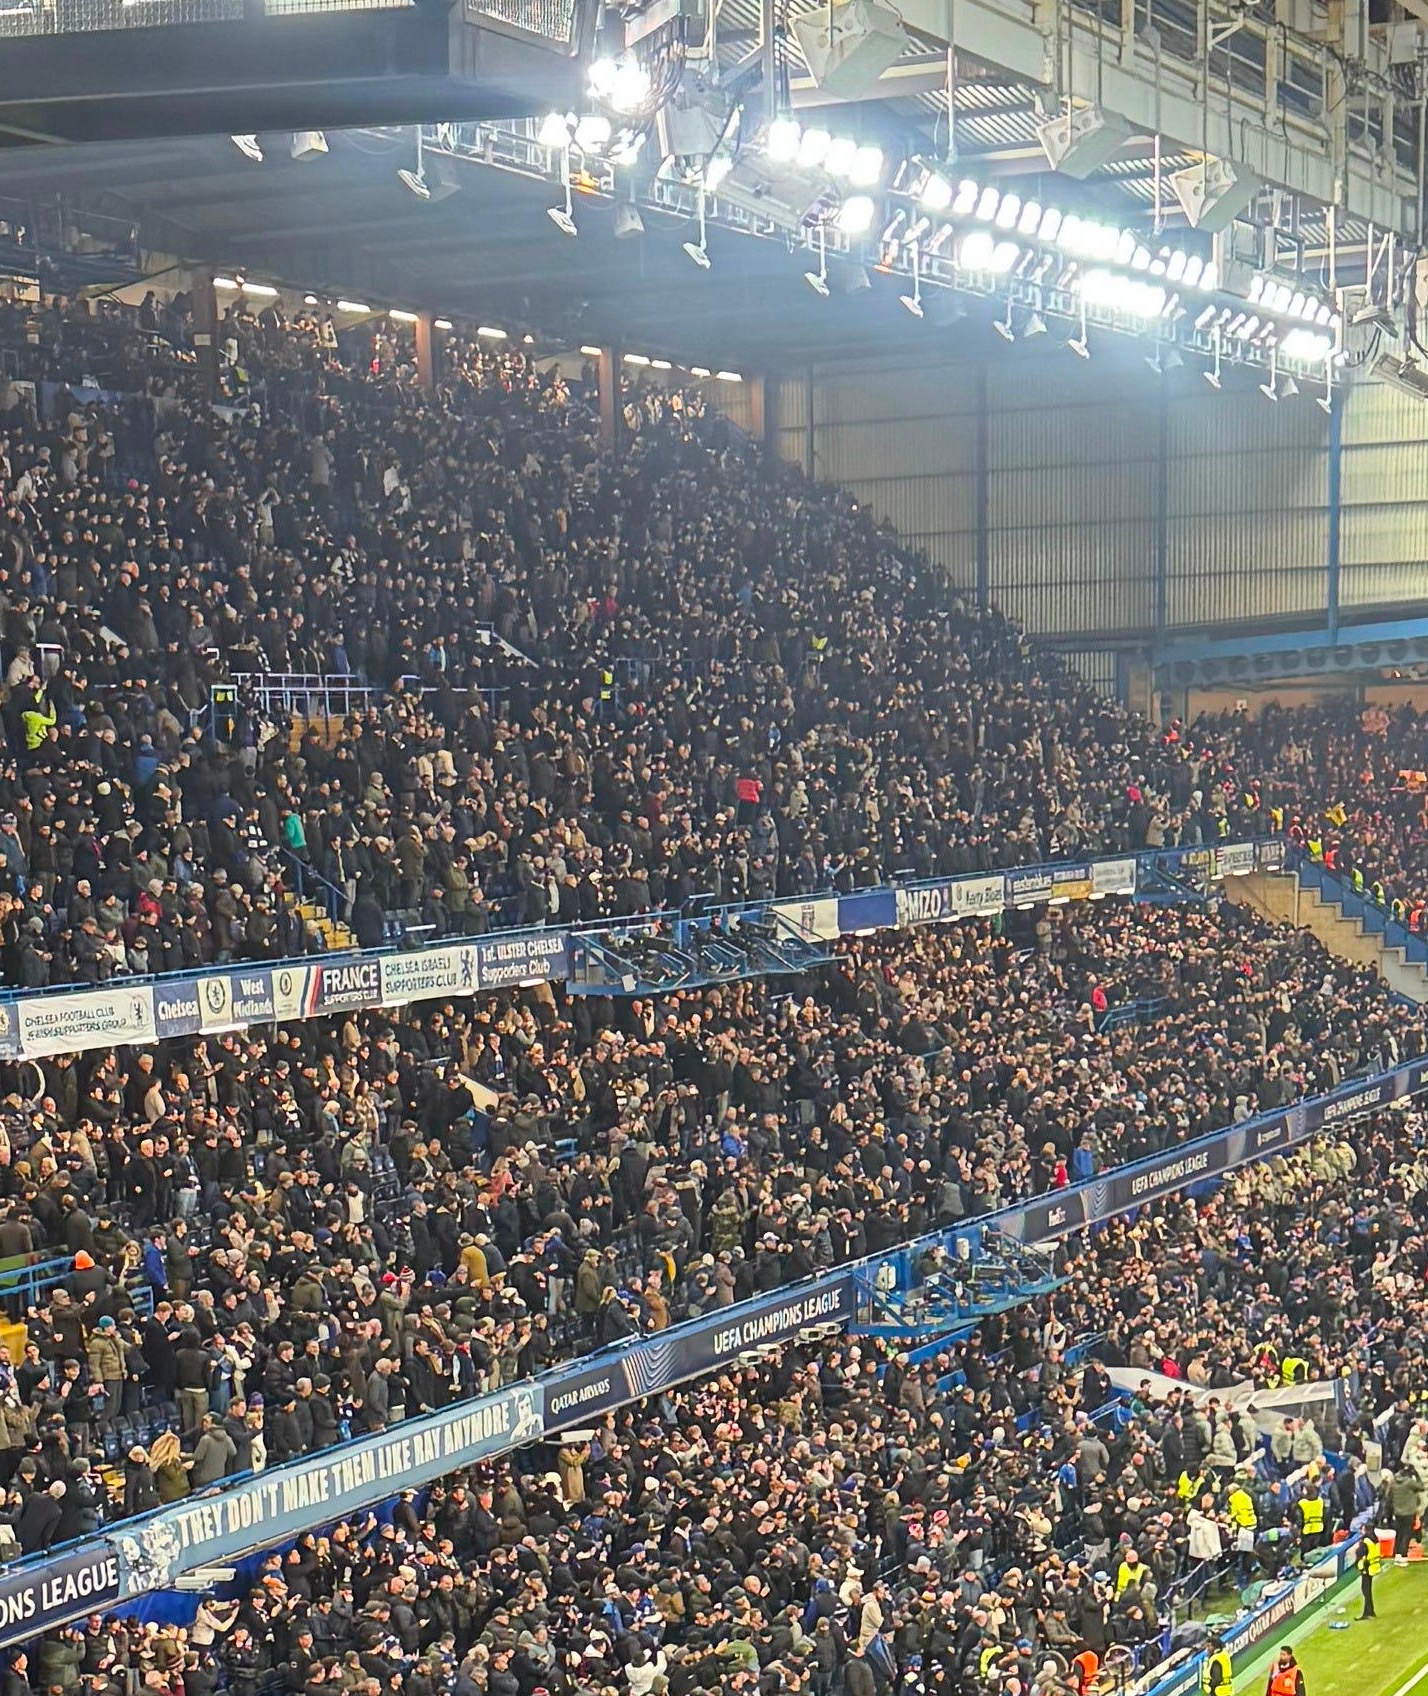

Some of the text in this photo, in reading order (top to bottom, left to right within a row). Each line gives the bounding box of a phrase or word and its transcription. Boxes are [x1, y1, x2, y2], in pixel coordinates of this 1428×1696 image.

[497, 942, 526, 961] ULSTER
[527, 937, 565, 957] CHELSEA
[385, 959, 420, 977] CHELSEA
[528, 958, 551, 975] Club
[240, 978, 265, 996] West
[323, 963, 379, 993] FRANCE
[435, 973, 458, 987] CLUB
[25, 1013, 58, 1027] CHELSEA
[60, 1007, 95, 1021] FOOTBALL
[158, 1000, 199, 1021] Chelsea
[232, 999, 272, 1018] Midlands
[714, 1288, 843, 1354] UEFA CHAMPIONS LEAGUE
[550, 1378, 611, 1415] QATAR AIRWAYS
[176, 1401, 510, 1549] THEY DON'T MAKE THEM LIKE RAY ANYMORE
[42, 1557, 119, 1611] LEAGUE
